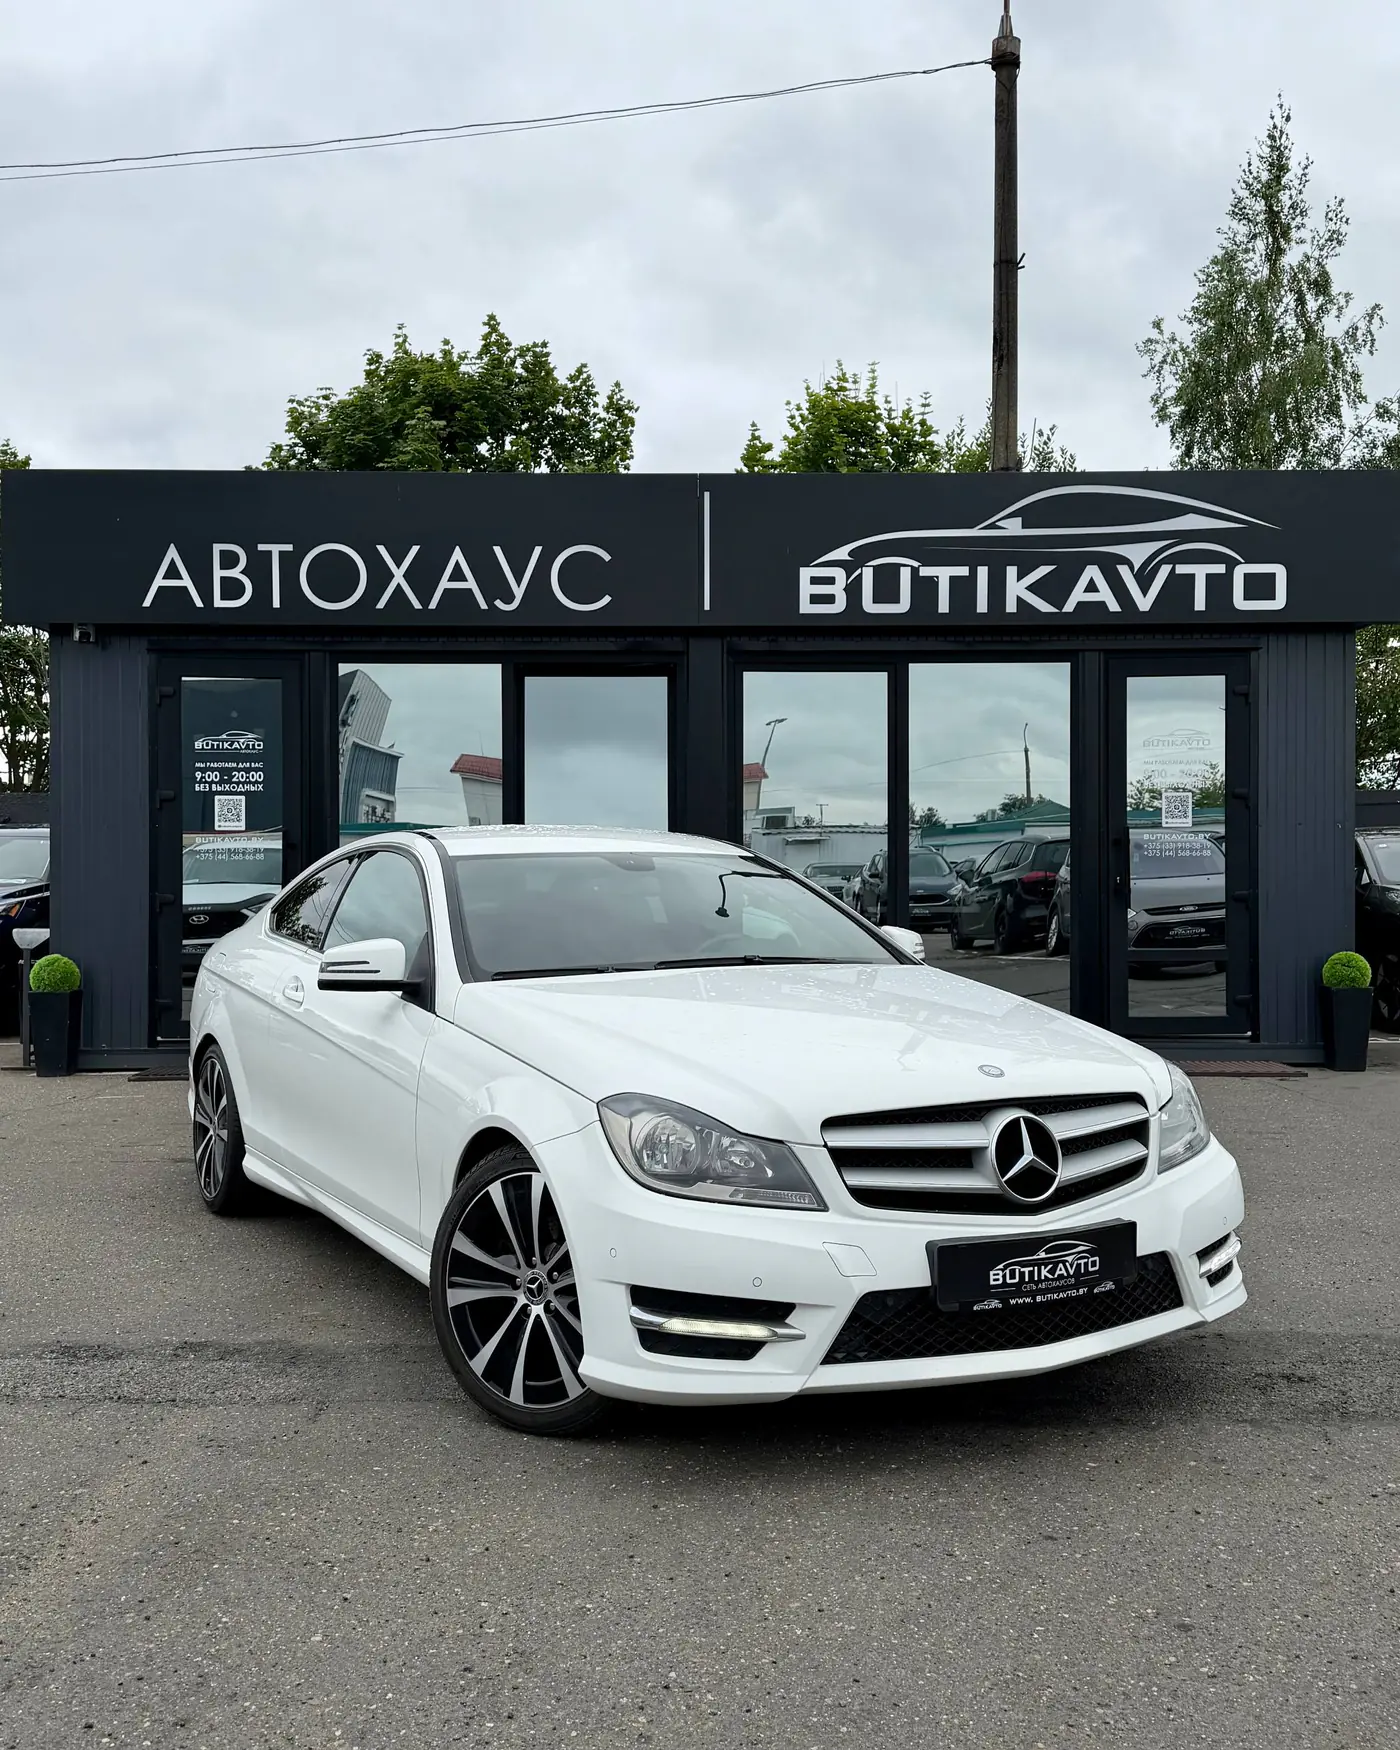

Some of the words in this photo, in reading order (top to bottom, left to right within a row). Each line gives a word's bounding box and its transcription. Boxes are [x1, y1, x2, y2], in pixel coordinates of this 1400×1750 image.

[142, 542, 612, 611] АВТОХАУС
[799, 562, 1288, 614] BUTIKAVTO
[194, 741, 264, 749] BUTIKAVTO
[1142, 738, 1211, 748] BUTIKAVTO
[194, 771, 220, 782] 9:00
[231, 771, 264, 782] 20:00
[194, 783, 209, 792] БЕЗ
[211, 783, 264, 792] ВЫХОДНЫХ
[1143, 842, 1161, 850] +375
[1162, 842, 1176, 851] (33)
[1177, 842, 1212, 850] 918-38-19
[215, 853, 228, 862] (44)
[1162, 850, 1176, 858] (44)
[989, 1257, 1100, 1285] BUTIKAVTO
[1021, 1283, 1037, 1291] СЕТЬ
[1038, 1278, 1075, 1290] АВТОХАУСОВ
[1035, 1287, 1088, 1302] BUTIKAVTO.BY
